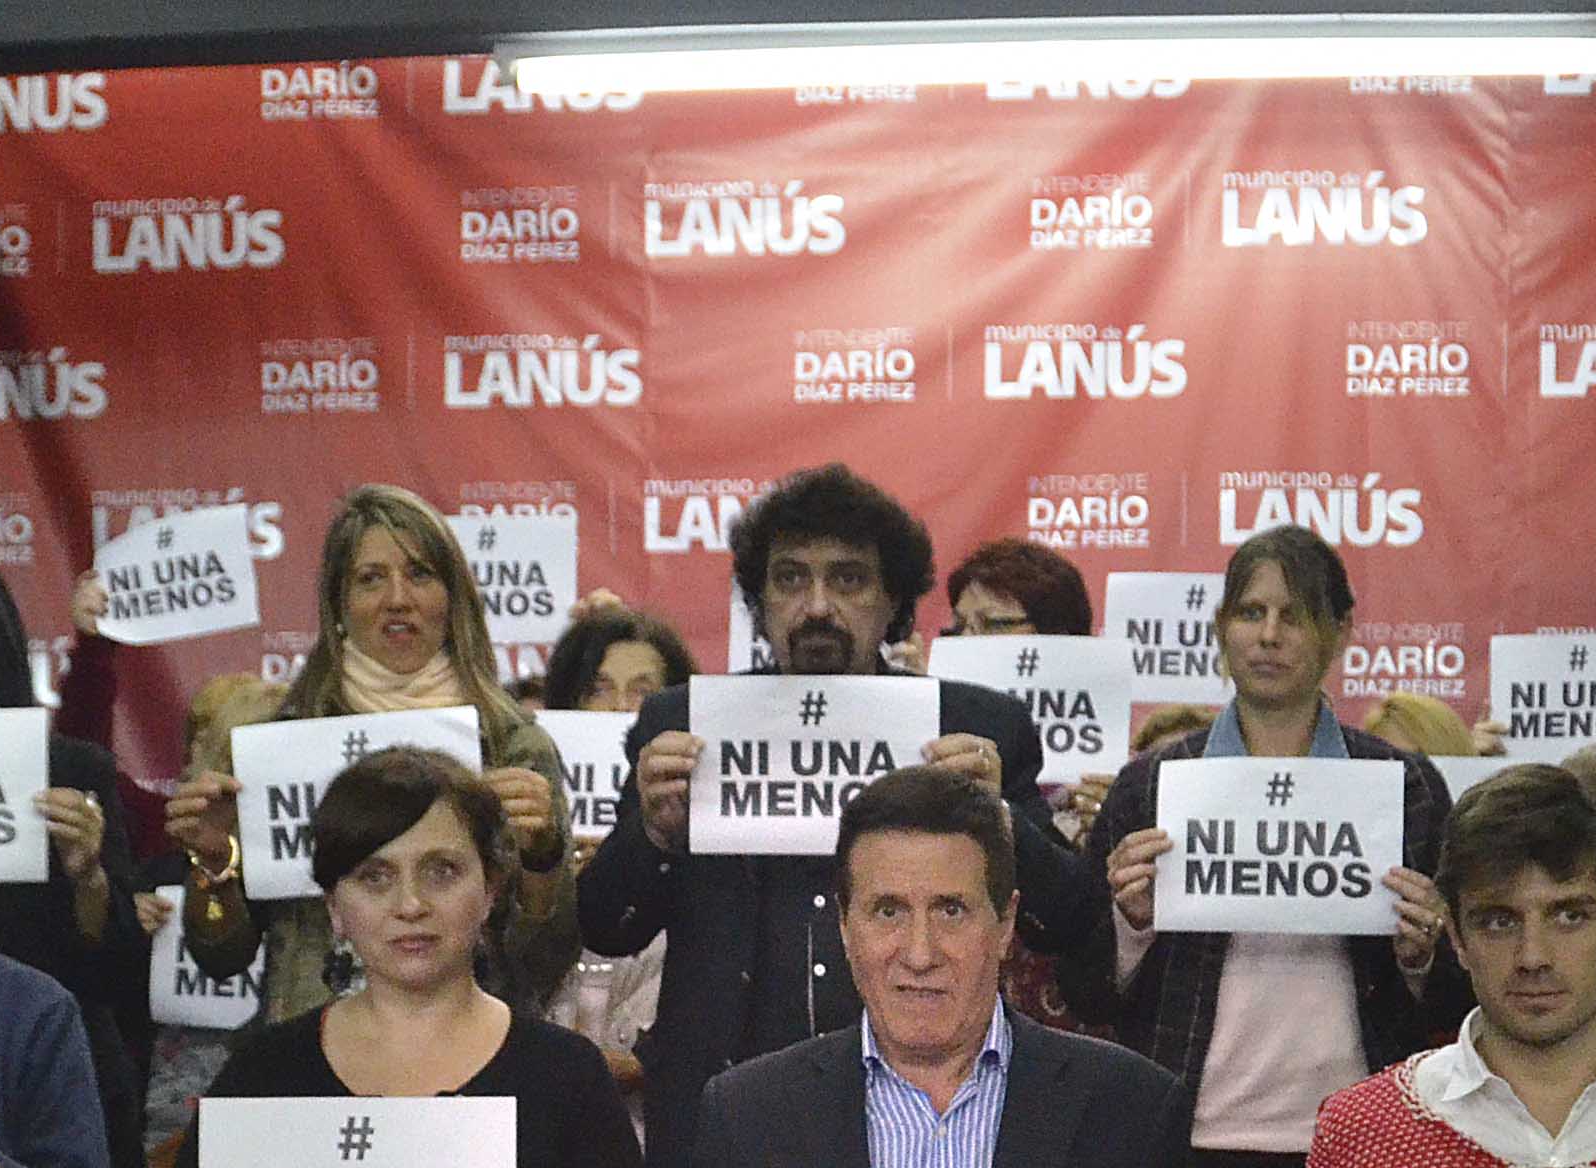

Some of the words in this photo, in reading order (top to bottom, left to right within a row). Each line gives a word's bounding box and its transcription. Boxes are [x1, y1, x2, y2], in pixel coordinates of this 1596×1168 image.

[261, 62, 378, 100] DARÍO
[645, 181, 753, 198] municipio
[1223, 171, 1336, 188] municipio
[94, 200, 198, 217] municipio
[461, 205, 579, 242] DARÍO
[645, 181, 846, 258] LANÚS
[1031, 193, 1153, 229] DARÍO
[1222, 170, 1429, 247] LANÚS
[94, 198, 285, 274] LANÚS
[445, 336, 549, 351] municipio
[985, 325, 1099, 341] municipio
[261, 353, 378, 392] DARÍO
[444, 335, 643, 409] LANÚS
[795, 345, 916, 383] DARÍO
[984, 325, 1188, 399] LANÚS
[1347, 338, 1470, 375] DARÍO
[645, 479, 754, 496] municipio
[1220, 471, 1332, 488] municipio
[1028, 491, 1149, 529] DARÍO
[1219, 472, 1424, 547] LANÚS
[478, 528, 498, 550] #
[108, 566, 144, 594] NI
[153, 550, 226, 586] UNA
[109, 578, 237, 623] MENOS
[1186, 583, 1206, 609] #
[1126, 618, 1164, 647] NI
[1015, 648, 1041, 679] #
[1343, 640, 1466, 676] DARÍO
[1569, 645, 1590, 670] #
[799, 692, 828, 727] #
[1510, 682, 1547, 708] NI
[720, 740, 771, 777] NI
[790, 739, 898, 777] UNA
[1265, 772, 1296, 806] #
[1185, 818, 1236, 856] NI
[1255, 819, 1365, 858] UNA
[1184, 860, 1374, 899] MENOS
[338, 1116, 375, 1161] #
